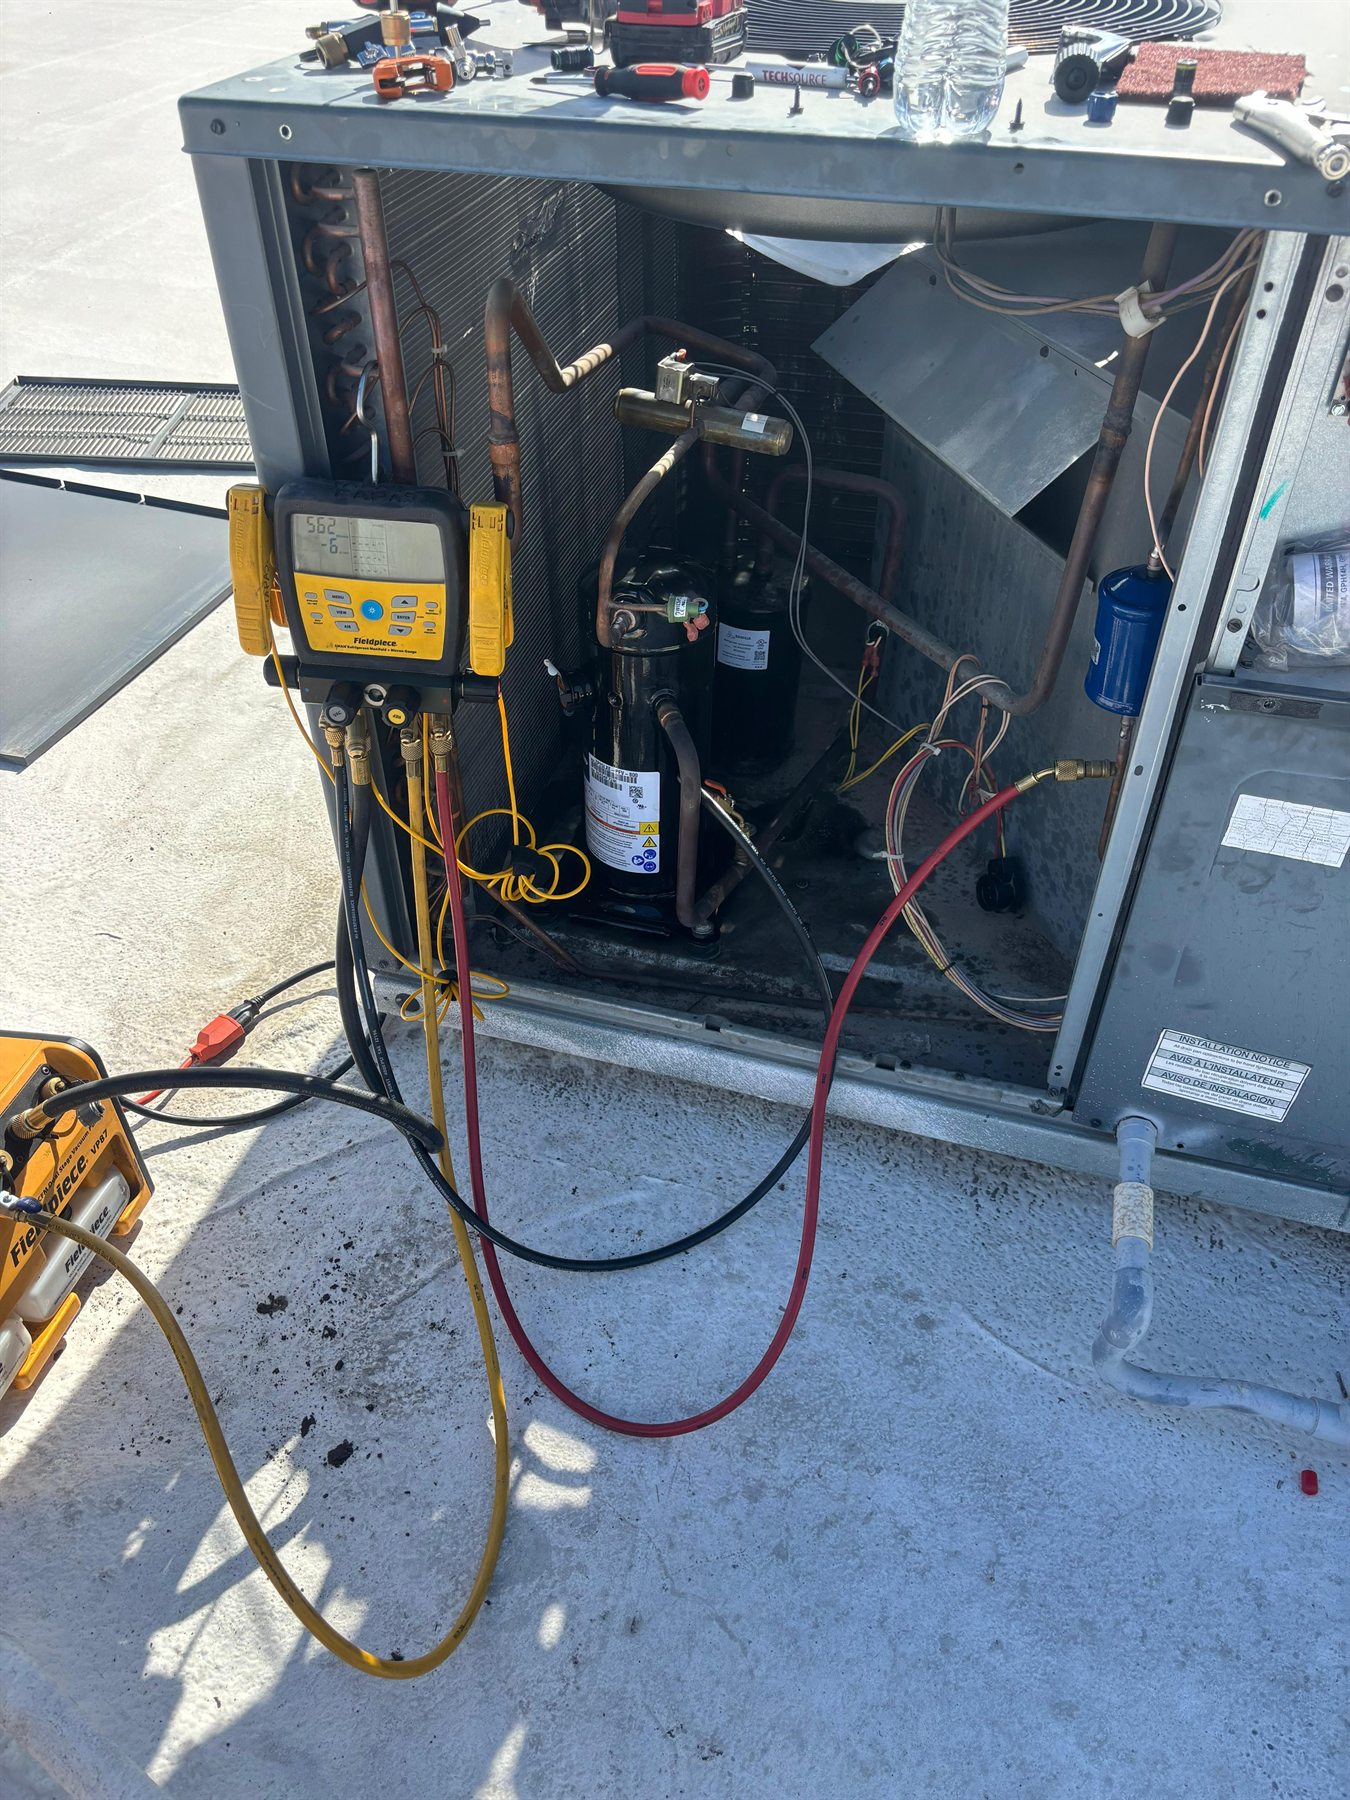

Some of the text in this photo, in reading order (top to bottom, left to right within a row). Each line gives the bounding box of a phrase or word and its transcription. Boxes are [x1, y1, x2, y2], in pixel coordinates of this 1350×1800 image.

[762, 69, 827, 86] TECHSOURCE
[307, 516, 336, 534] 562
[353, 637, 397, 648] Fieldpiece
[1178, 1034, 1291, 1068] INSTALLATION NOTICE
[1169, 1052, 1193, 1064] AVIS
[1202, 1061, 1285, 1088] L'INSTALLATEUR
[1160, 1070, 1276, 1105] AVISO DE INSTALACIÓN
[59, 1154, 73, 1174] Stage
[71, 1129, 90, 1155] Vacuum
[90, 1128, 108, 1155] VP87
[10, 1154, 88, 1268] Fiepiece
[65, 1206, 109, 1273] Fieliece
